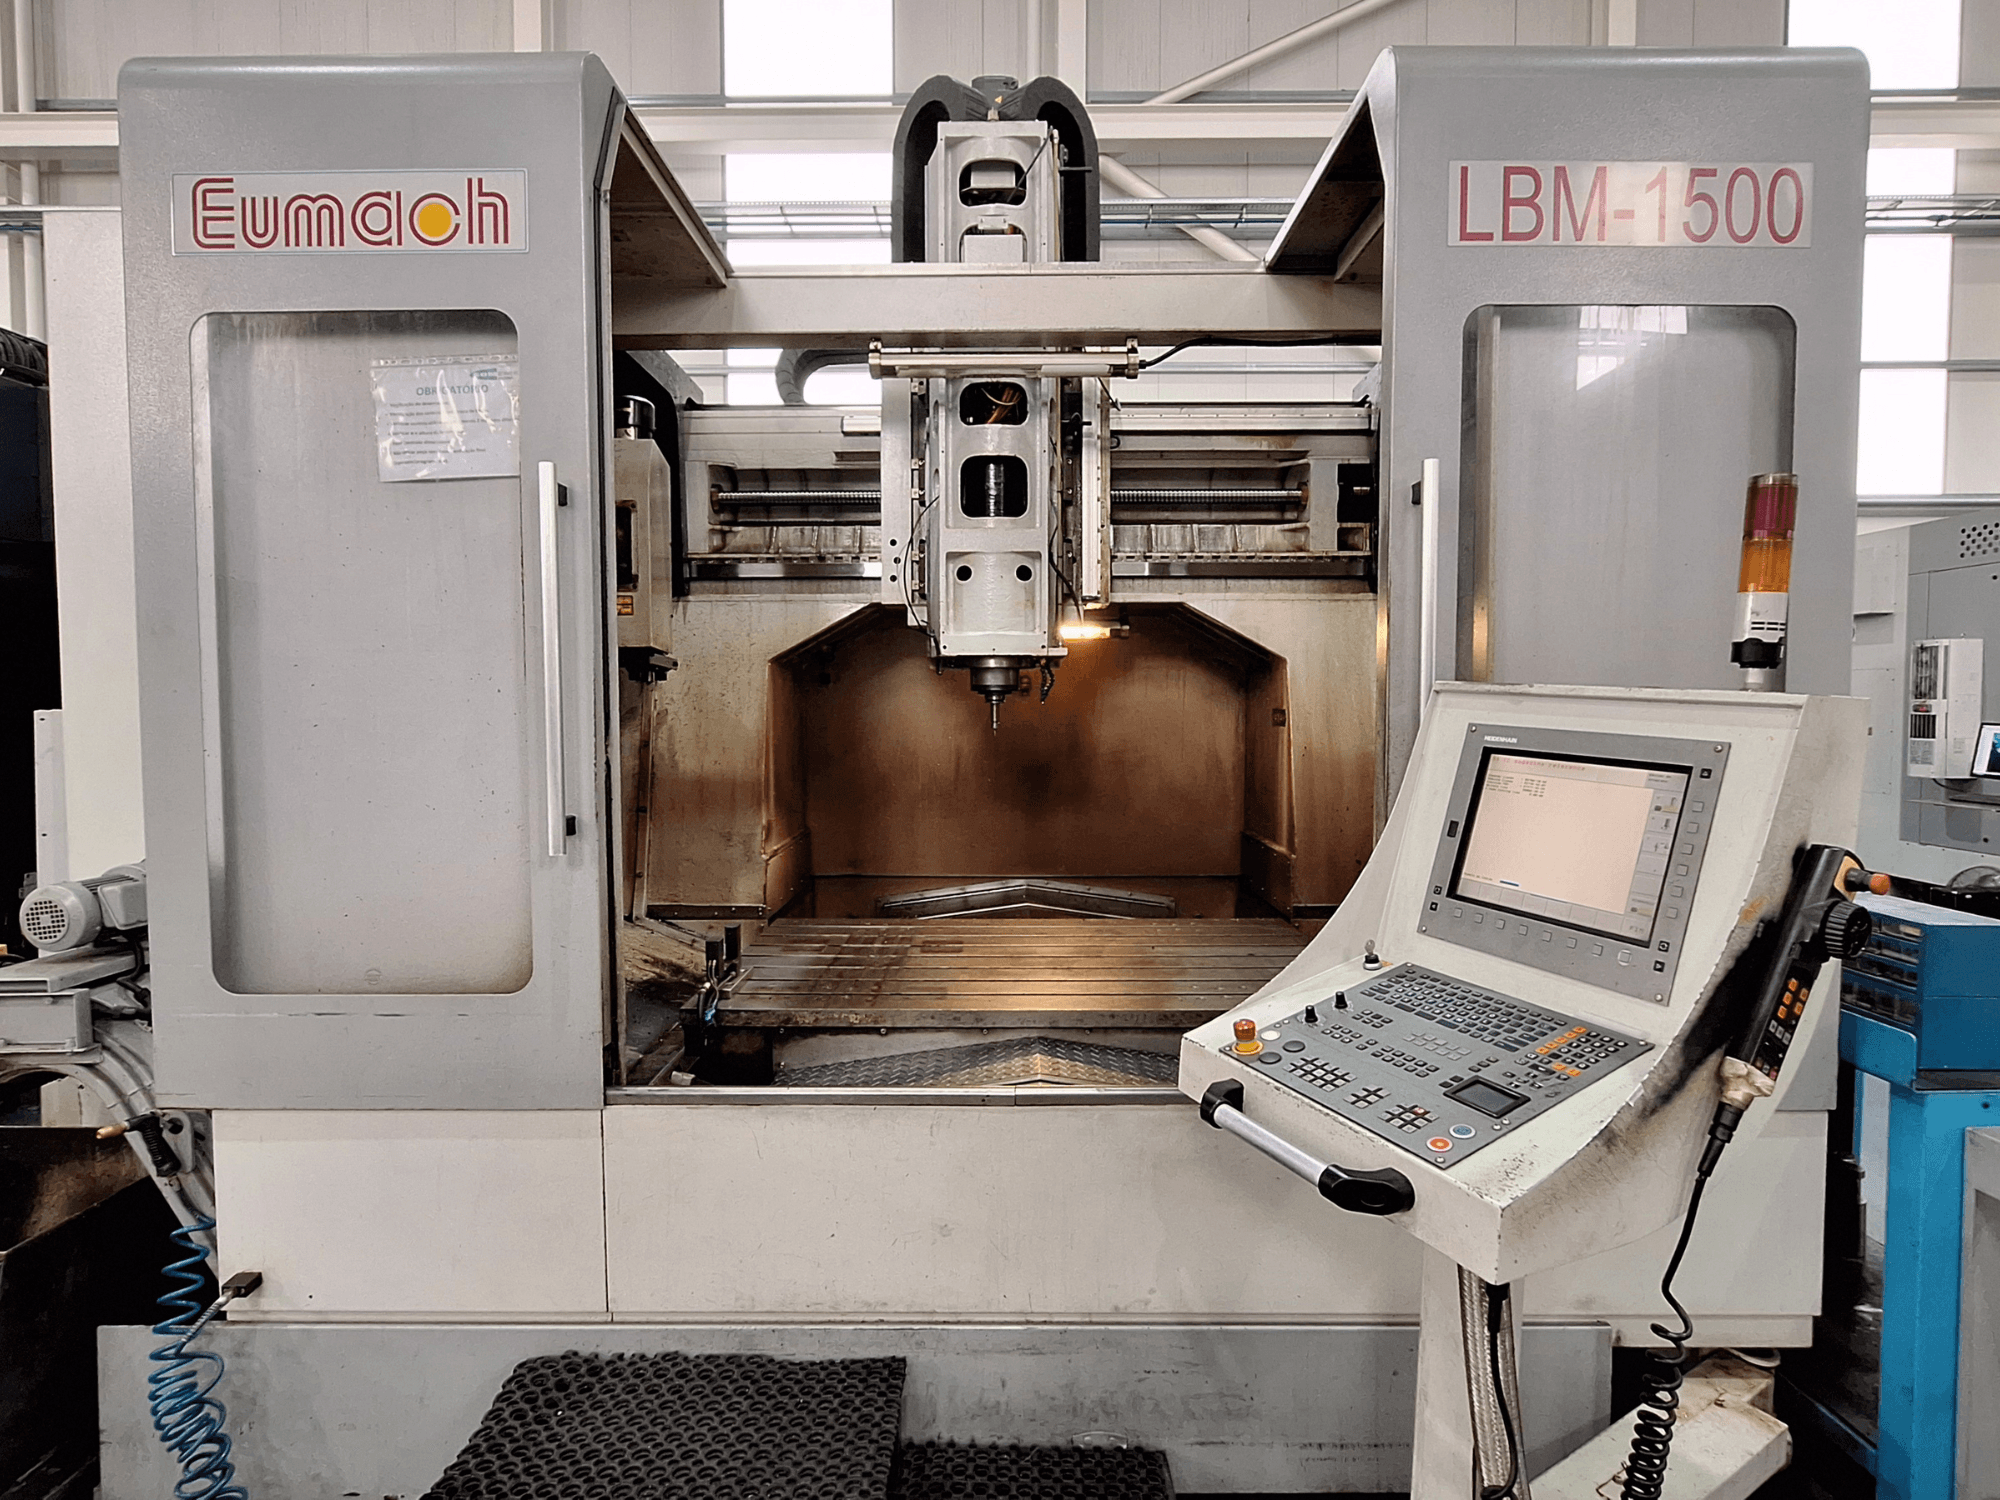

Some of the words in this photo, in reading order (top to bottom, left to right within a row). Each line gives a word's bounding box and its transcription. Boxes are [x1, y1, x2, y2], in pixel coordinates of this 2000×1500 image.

[191, 177, 510, 250] Eumach
[1459, 165, 1804, 244] LBM-1500
[416, 383, 489, 396] OBRGATÓRIO
